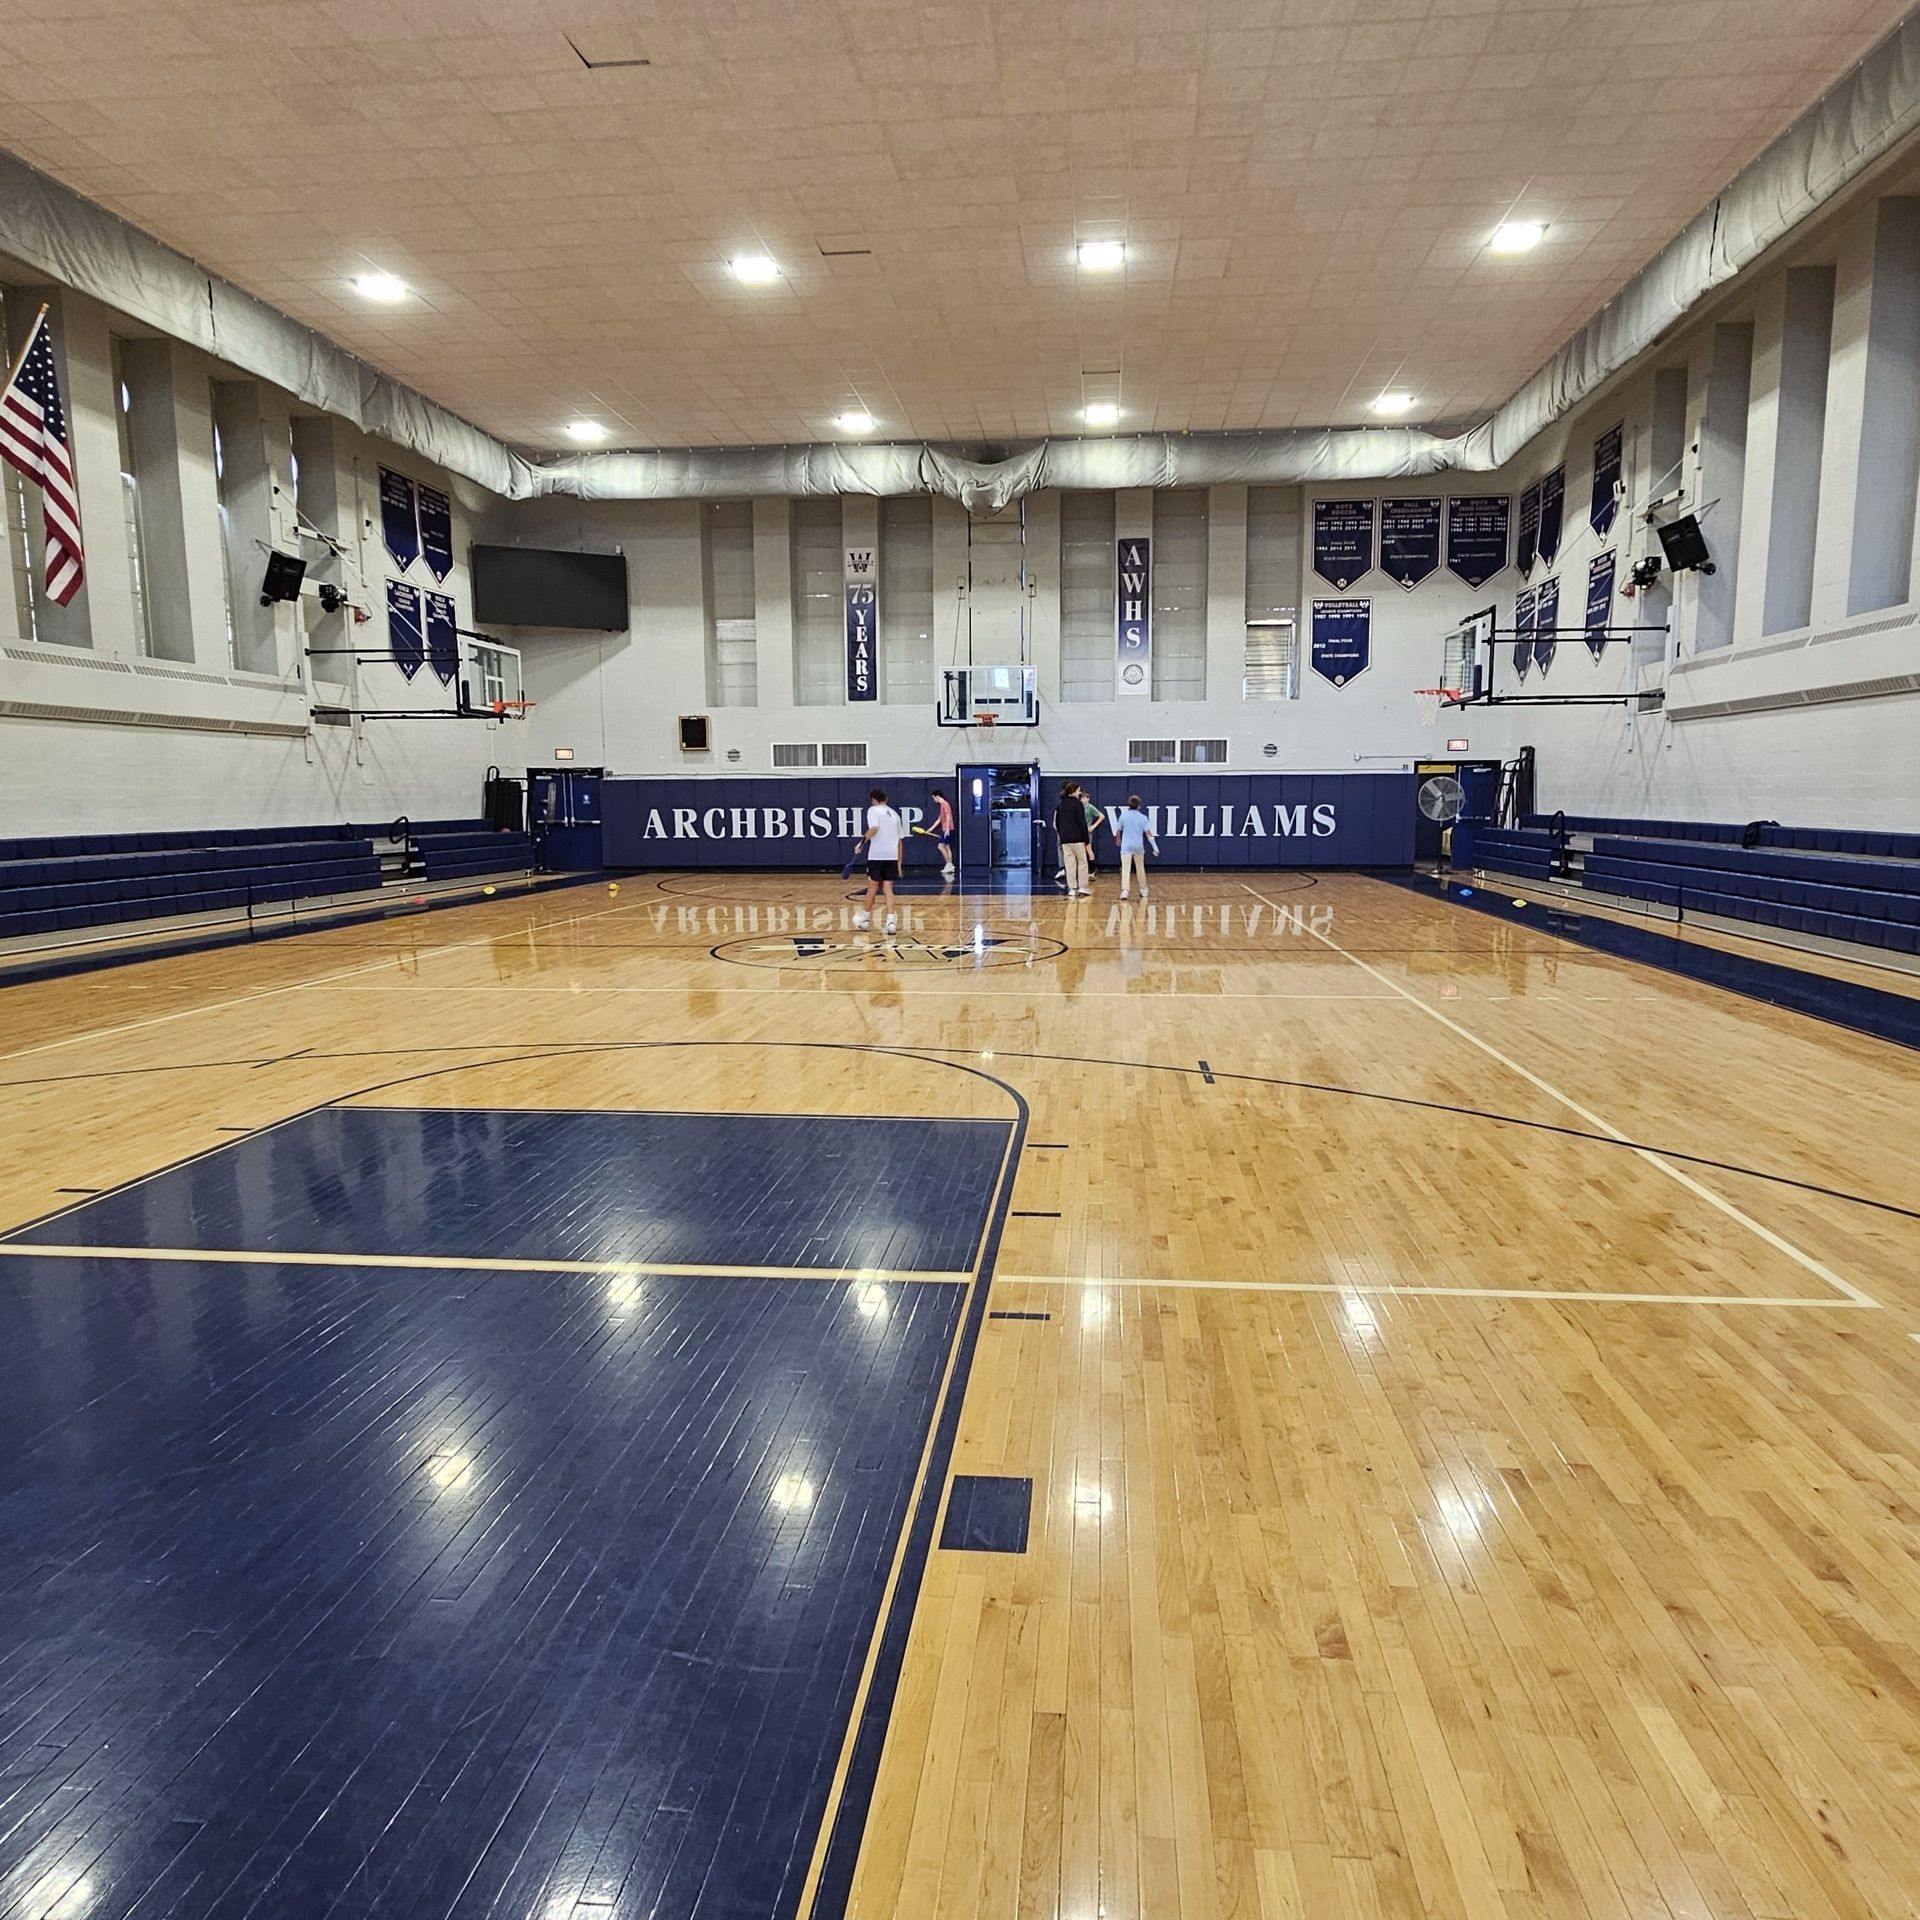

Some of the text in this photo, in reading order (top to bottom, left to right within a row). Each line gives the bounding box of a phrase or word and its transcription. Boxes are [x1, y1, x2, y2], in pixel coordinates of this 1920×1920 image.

[849, 584, 873, 604] 75
[1121, 545, 1145, 648] AWHS
[855, 610, 869, 691] YEARS
[643, 807, 924, 839] ARCHBISHP
